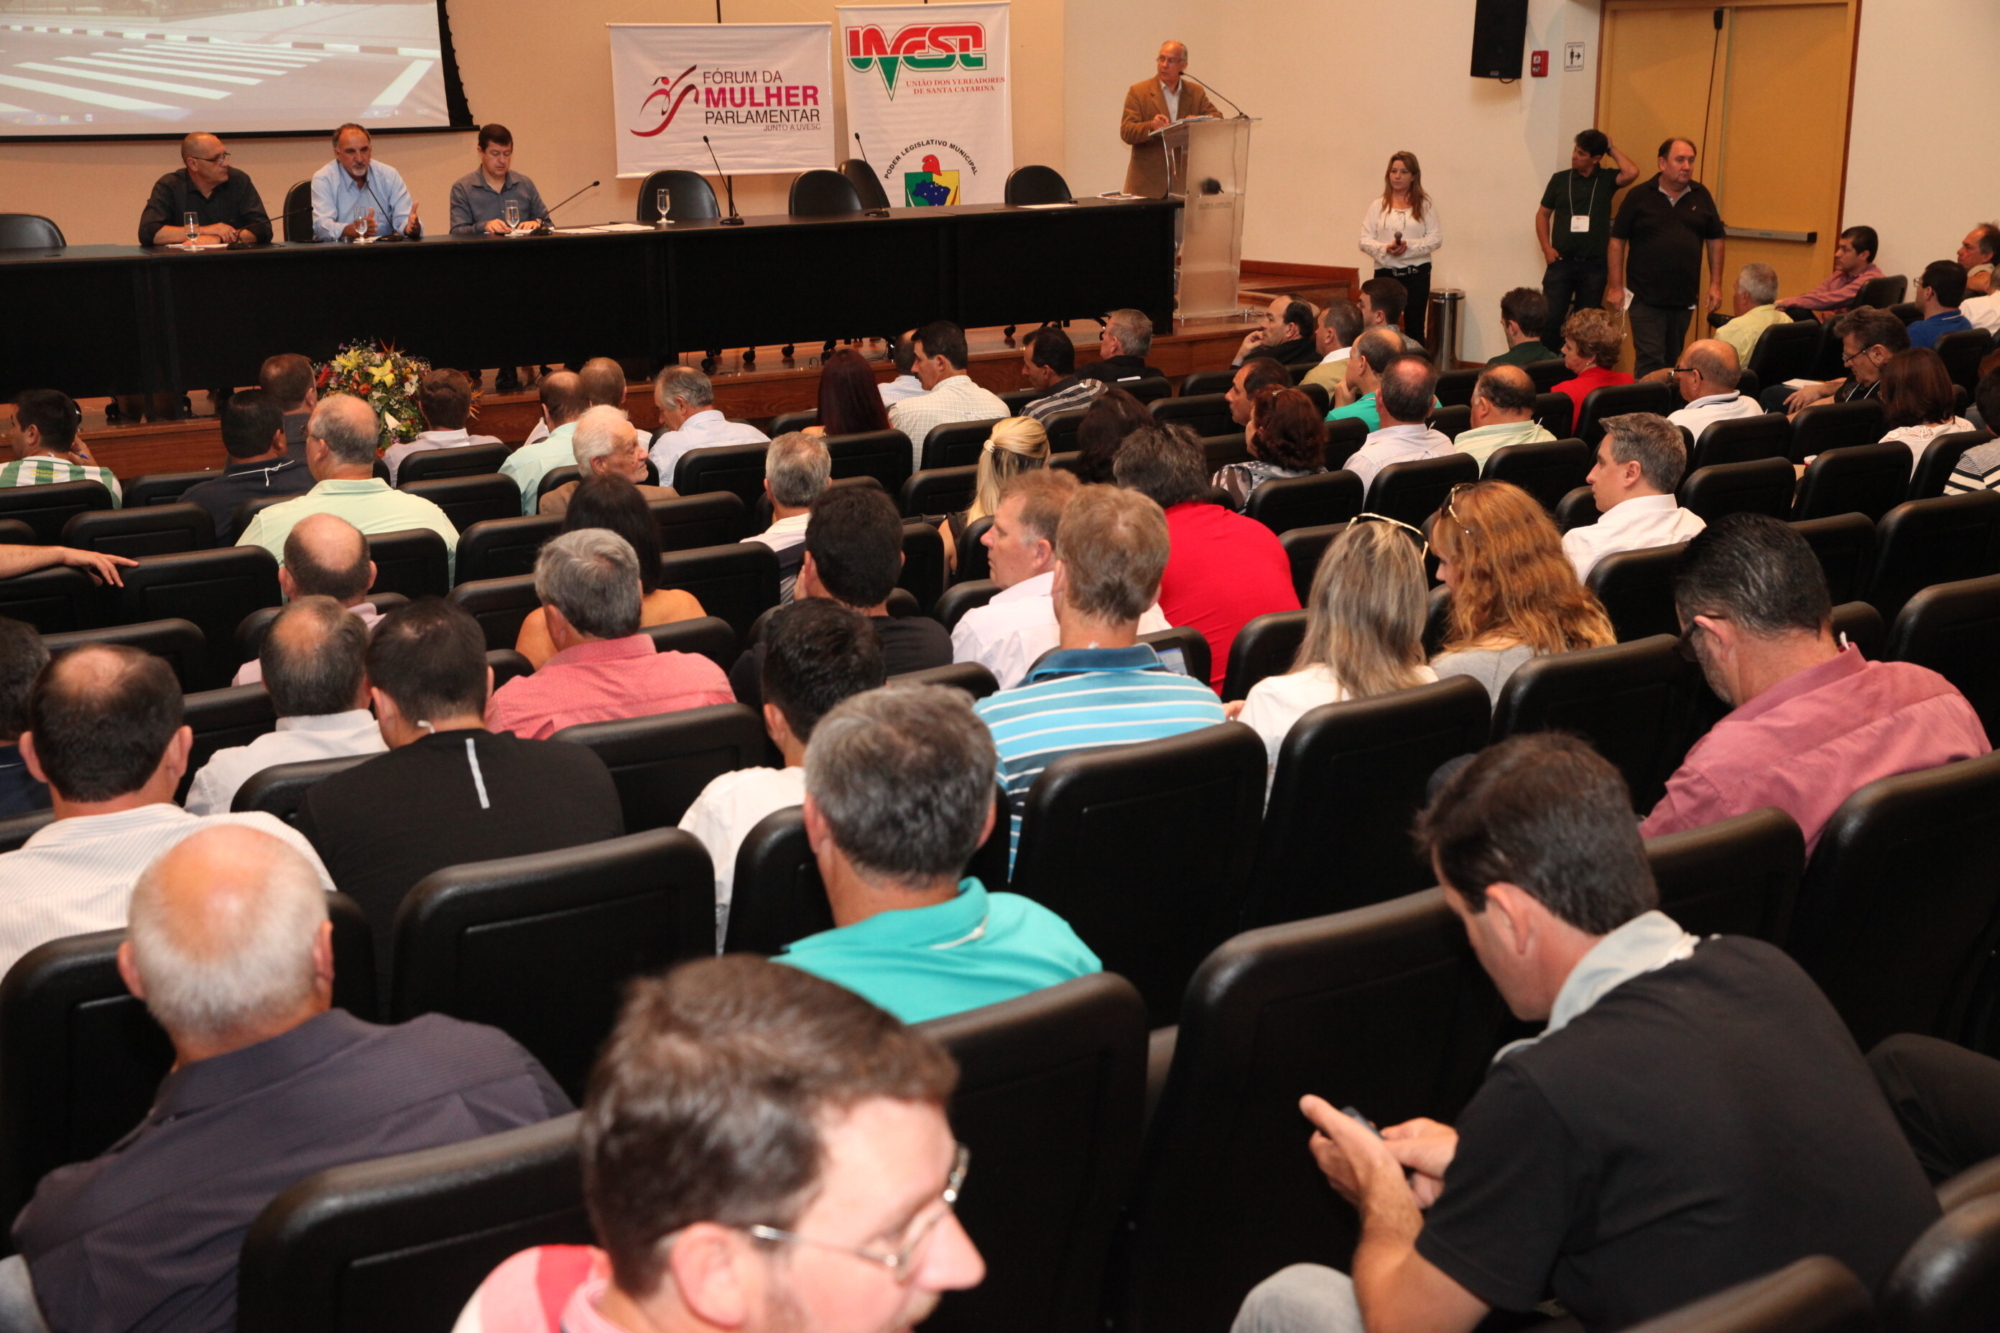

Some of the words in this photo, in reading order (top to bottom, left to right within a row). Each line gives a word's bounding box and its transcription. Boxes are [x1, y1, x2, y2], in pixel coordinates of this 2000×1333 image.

[703, 68, 757, 84] FÓRUM
[762, 71, 783, 83] DA
[906, 79, 932, 87] UNIÃO
[951, 77, 1005, 85] VEREADORES
[705, 85, 819, 108] MULHER
[954, 85, 995, 93] CATARINA
[705, 109, 820, 124] PARLAMENTAR
[796, 123, 821, 131] UVESC
[884, 155, 901, 179] PODER
[900, 139, 948, 156] LEGISLATIVO
[948, 143, 979, 176] MUNICIPAL
